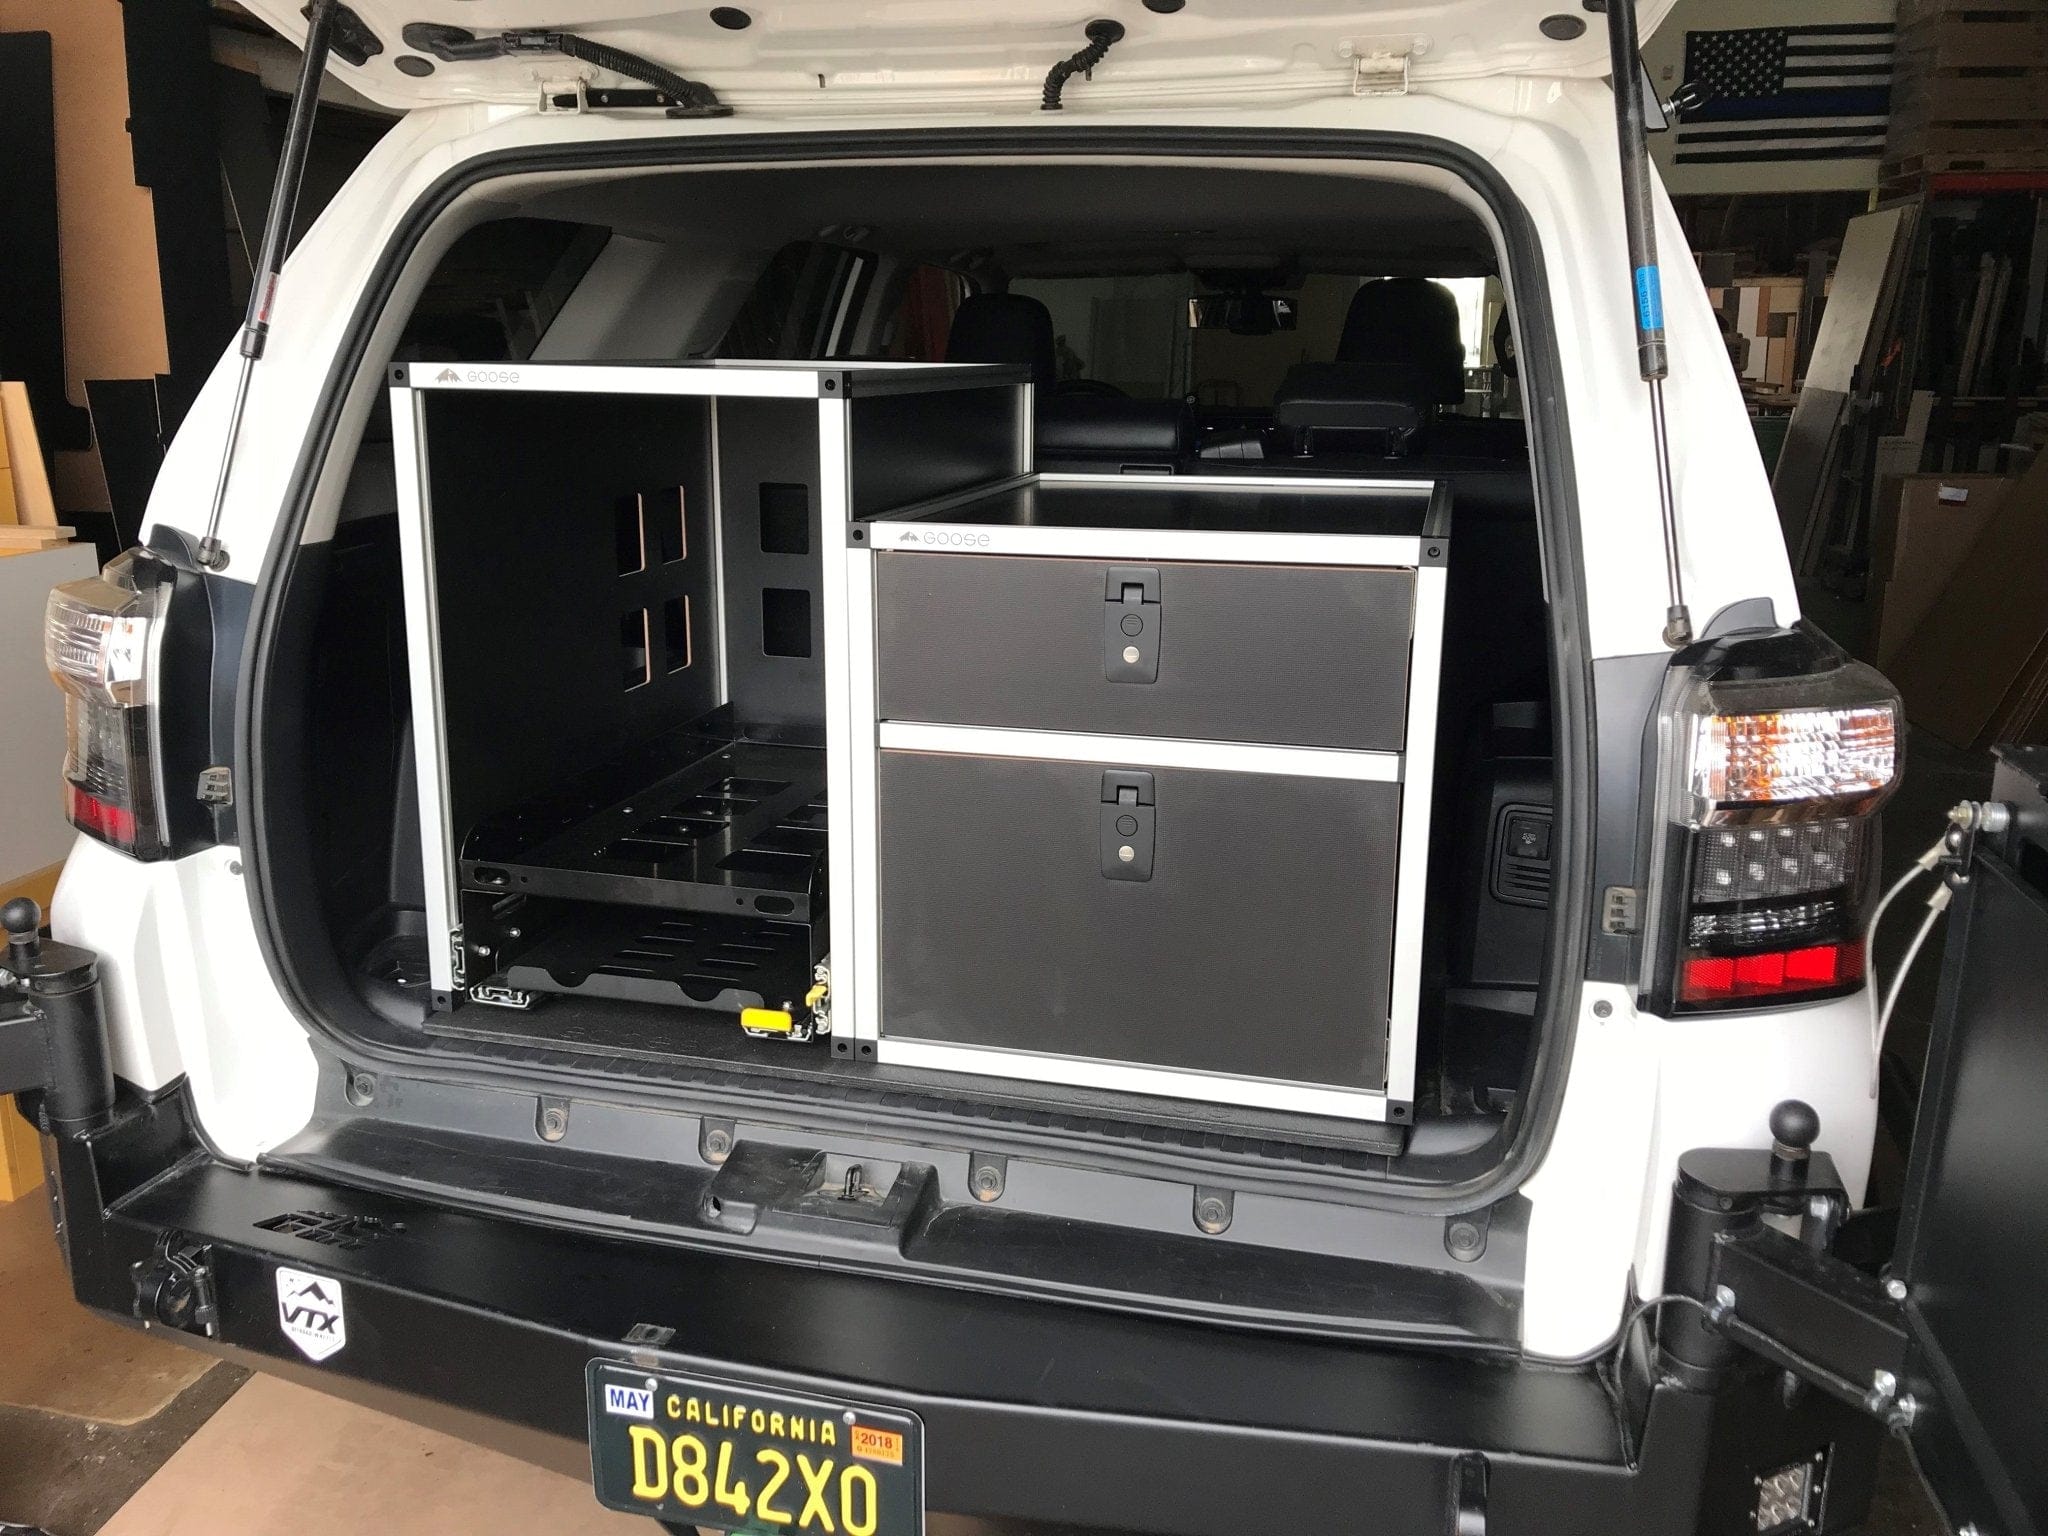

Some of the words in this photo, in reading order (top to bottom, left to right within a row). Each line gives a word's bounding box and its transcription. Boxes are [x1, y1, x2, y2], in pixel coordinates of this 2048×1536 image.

[281, 1302, 339, 1334] VTX
[609, 1388, 650, 1413] MAY
[666, 1394, 836, 1446] CALIFORNIA
[861, 1432, 893, 1449] 2018
